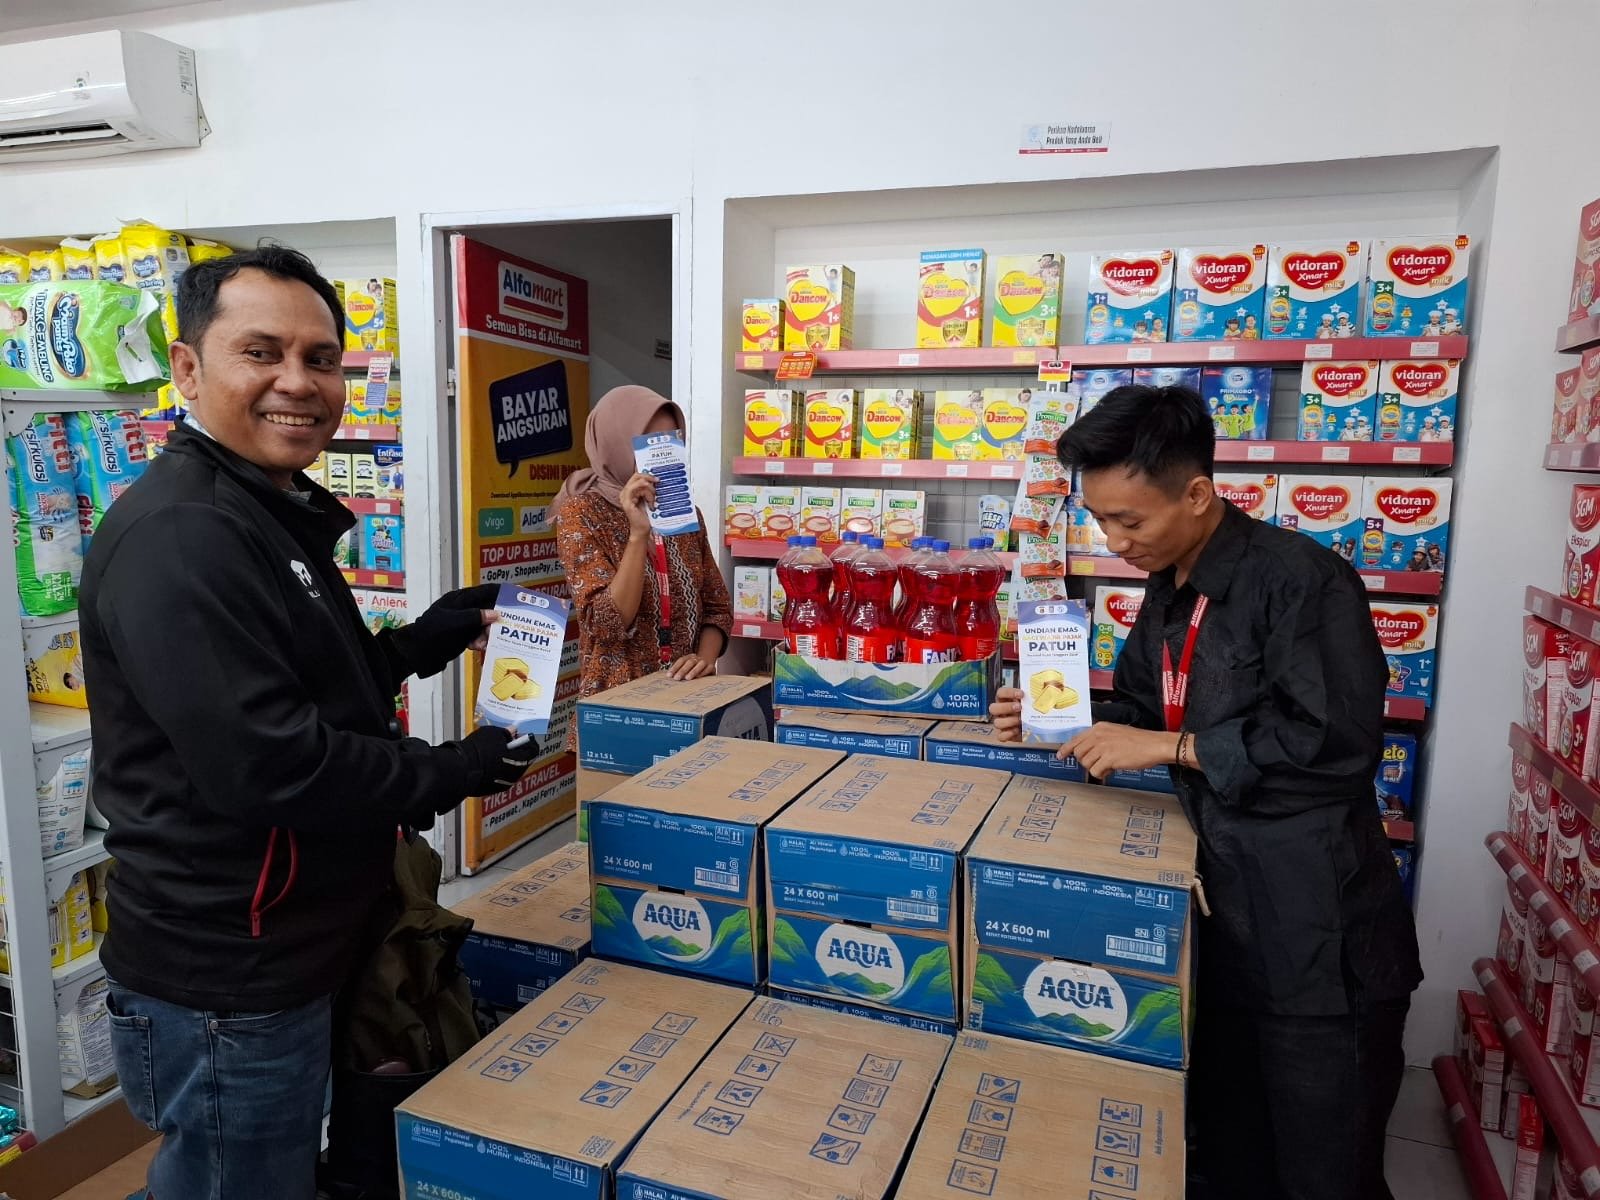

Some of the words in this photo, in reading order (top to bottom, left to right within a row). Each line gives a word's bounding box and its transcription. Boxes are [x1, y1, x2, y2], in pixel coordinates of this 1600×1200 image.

[1288, 260, 1339, 271] vidoran
[1392, 254, 1446, 266] vidoran
[1105, 266, 1154, 278] vidoran
[1196, 263, 1246, 274] vidoran
[503, 269, 564, 308] Alfamart
[999, 284, 1042, 296] Dancow
[1273, 288, 1288, 298] 3+
[1376, 282, 1392, 293] 3+
[790, 292, 828, 304] Dancow
[1094, 294, 1106, 304] 1+
[1184, 290, 1198, 300] 1+
[348, 301, 374, 311] Dancow
[964, 306, 978, 318] 1+
[1040, 304, 1056, 316] 3+
[374, 318, 384, 328] 5+
[828, 312, 840, 324] 1+
[486, 314, 517, 336] Semua
[518, 322, 537, 340] Bisa
[538, 328, 547, 342] di
[547, 331, 582, 350] Alfamart
[1318, 370, 1362, 380] vidoran
[1396, 370, 1442, 380] vidoran
[502, 387, 560, 421] BAYAR
[1306, 396, 1320, 404] 3+
[1384, 396, 1398, 404] 3+
[808, 410, 842, 422] Dancow
[867, 410, 901, 422] Dancow
[986, 412, 1026, 424] Dancow
[496, 409, 568, 444] ANGSURAN
[118, 410, 147, 461] Fitti
[780, 430, 790, 438] 1+
[840, 430, 850, 438] 1+
[898, 430, 910, 440] 3+
[47, 415, 71, 472] Fitti
[530, 464, 560, 481] DISINI
[1296, 494, 1344, 504] vidoran
[1380, 496, 1432, 506] vidoran
[1575, 496, 1594, 520] SGM
[485, 517, 504, 530] virgo
[1282, 516, 1296, 526] 5+
[1366, 520, 1380, 530] 5+
[482, 548, 503, 564] TOP
[506, 546, 520, 560] UP
[523, 545, 530, 558] &
[532, 542, 558, 558] BAYA
[1582, 563, 1594, 584] 3+
[371, 595, 408, 609] Anlene
[500, 612, 532, 624] UNDIAN
[533, 620, 557, 630] EMAS
[500, 626, 551, 647] PATUH
[1025, 628, 1056, 640] UNDIAN
[1058, 627, 1078, 638] EMAS
[1028, 642, 1076, 652] PATUH
[1526, 634, 1538, 653] SGM
[1418, 658, 1432, 669] 1+
[1570, 650, 1588, 672] SGM
[1172, 672, 1184, 706] Alfamart
[946, 700, 980, 708] MURNI
[948, 694, 978, 702] 100%
[1574, 724, 1584, 746] 3+
[600, 752, 608, 760] 1.5
[1515, 763, 1527, 778] SGM
[482, 788, 515, 812] TIKET
[515, 781, 524, 796] &
[525, 763, 560, 790] TRAVEL
[1534, 781, 1546, 798] SGM
[522, 794, 540, 811] Kapal
[1559, 800, 1576, 822] SGM
[684, 828, 714, 837] INDONESIA
[850, 846, 869, 854] 100%
[604, 856, 614, 865] 24
[616, 858, 622, 866] X
[624, 859, 640, 869] 600
[642, 862, 653, 872] ml
[874, 855, 909, 863] INDONESIA
[1565, 866, 1574, 885] 3+
[1066, 879, 1087, 887] 100%
[1102, 884, 1124, 892] 100%
[784, 887, 795, 896] 24
[797, 888, 804, 898] X
[806, 890, 825, 901] 600
[826, 892, 838, 902] ml
[1092, 889, 1132, 900] INDONESIA
[1590, 897, 1600, 917] 3+
[643, 904, 701, 932] AQUA
[986, 920, 999, 930] 24
[1002, 922, 1010, 932] X
[1012, 924, 1033, 936] 600
[1036, 928, 1050, 939] ml
[827, 938, 893, 969] AQUA
[1038, 976, 1114, 1010] AQUA
[852, 1008, 870, 1016] 100%
[882, 1014, 900, 1022] 100%
[486, 1148, 512, 1160] MURNI
[488, 1142, 509, 1154] 100%
[514, 1156, 550, 1170] INDONESIA
[522, 1152, 542, 1162] 100%
[416, 1181, 429, 1192] 24
[430, 1184, 439, 1196] X
[441, 1186, 461, 1200] 600
[644, 1190, 663, 1200] HALAL
